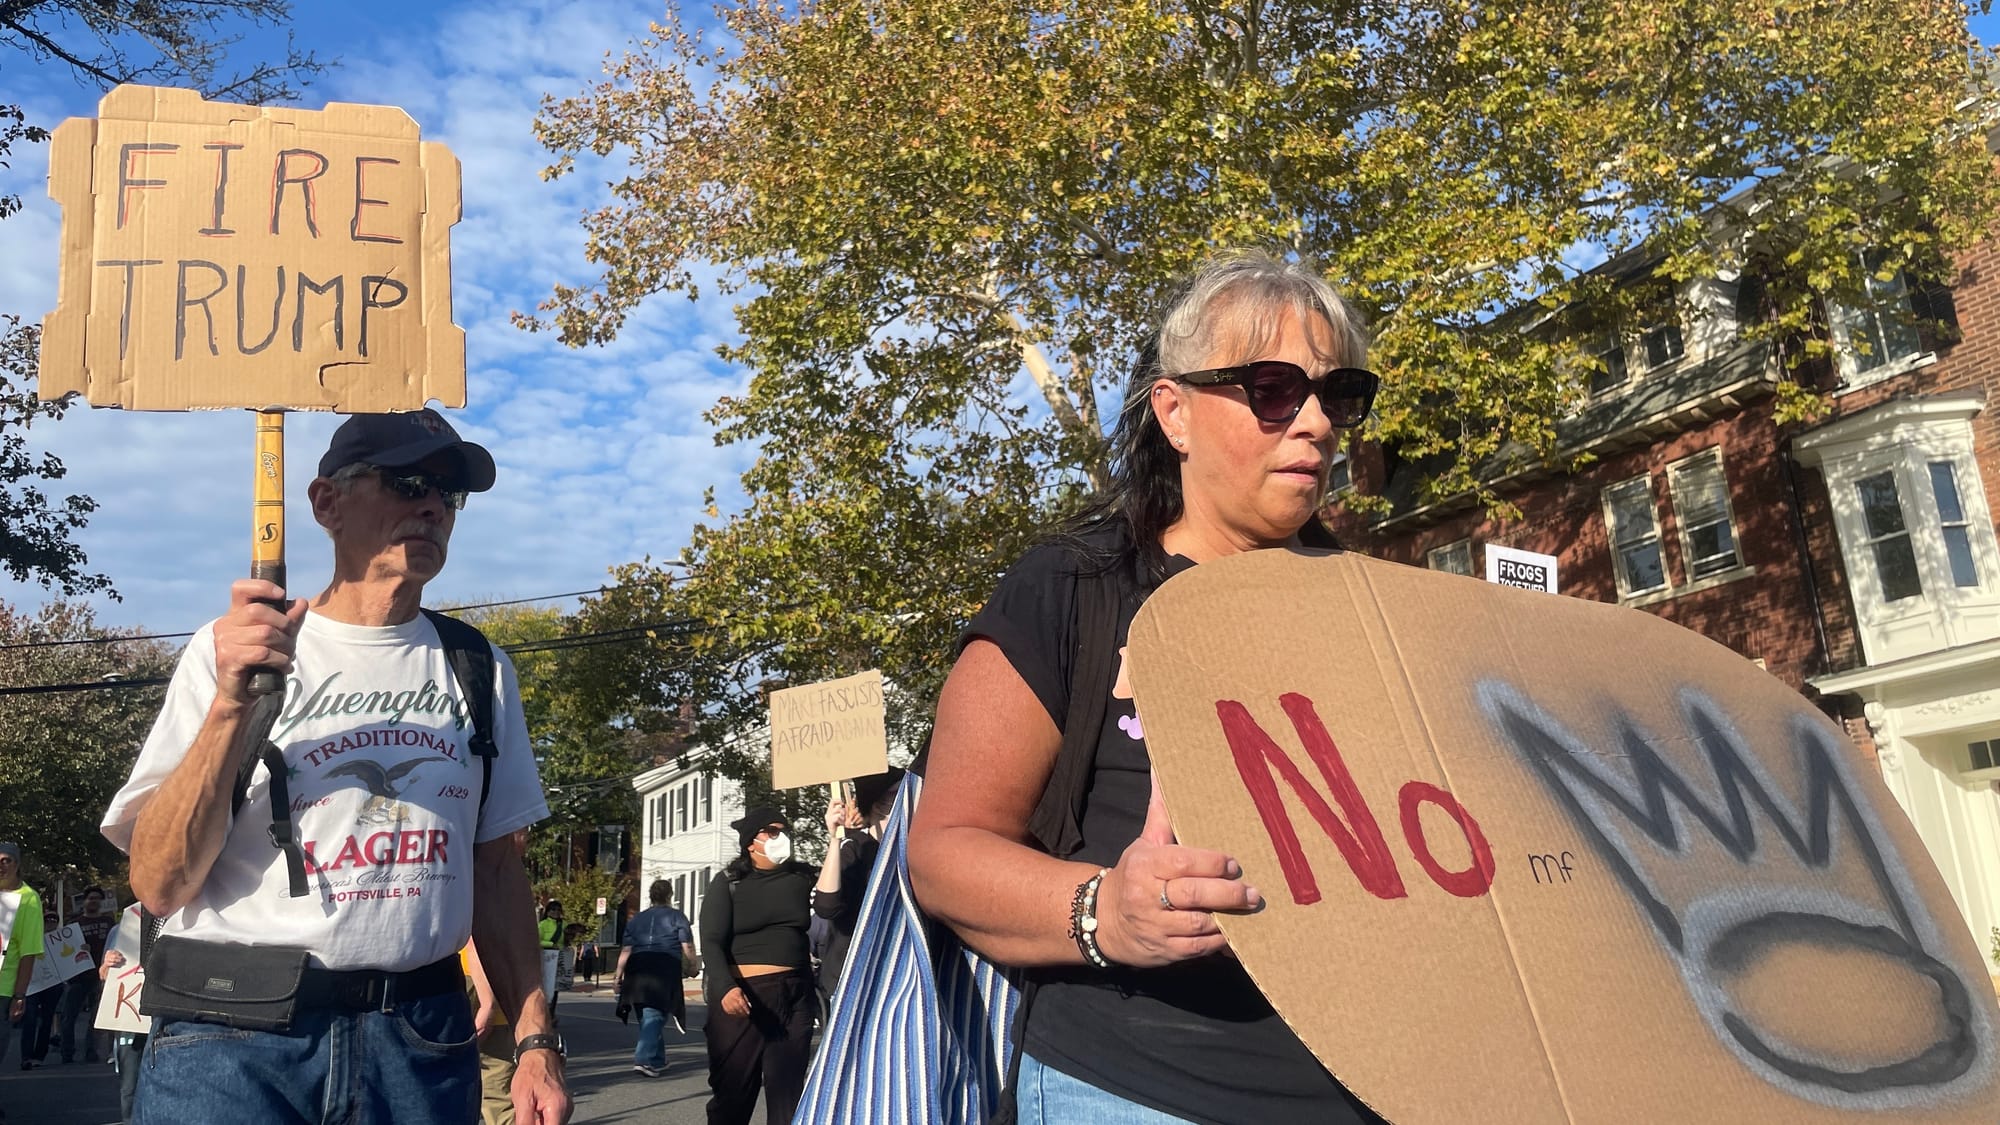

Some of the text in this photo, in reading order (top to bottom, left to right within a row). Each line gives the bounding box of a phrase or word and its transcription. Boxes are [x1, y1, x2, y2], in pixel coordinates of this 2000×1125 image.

[117, 140, 404, 244] FIRE
[96, 259, 409, 361] TRUMP
[1499, 561, 1545, 583] FROGS
[272, 671, 470, 743] Yuengling
[777, 680, 881, 723] MAKE FASCISTS
[303, 729, 458, 768] TRADITIONAL
[776, 721, 834, 757] AFRAID
[437, 784, 469, 799] 1829
[1215, 692, 1496, 905] No
[303, 829, 449, 876] LAGER
[328, 887, 421, 903] POTTSVILLE, PA
[49, 926, 73, 945] NO
